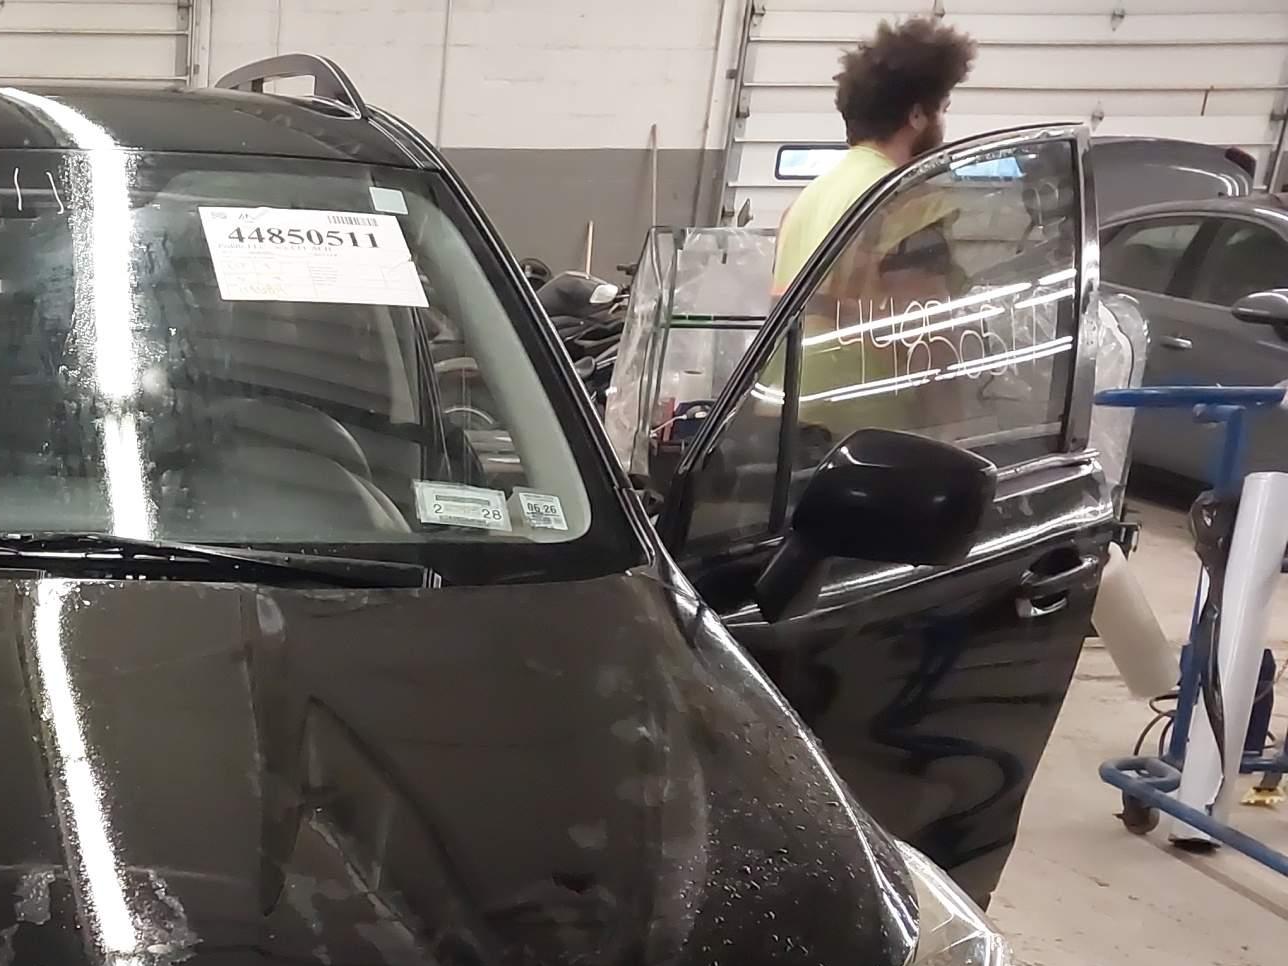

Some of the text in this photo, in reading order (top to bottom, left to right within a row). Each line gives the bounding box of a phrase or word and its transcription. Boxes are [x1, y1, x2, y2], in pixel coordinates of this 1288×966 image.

[228, 226, 380, 249] 44850511
[432, 503, 444, 514] 2
[481, 508, 503, 520] 28
